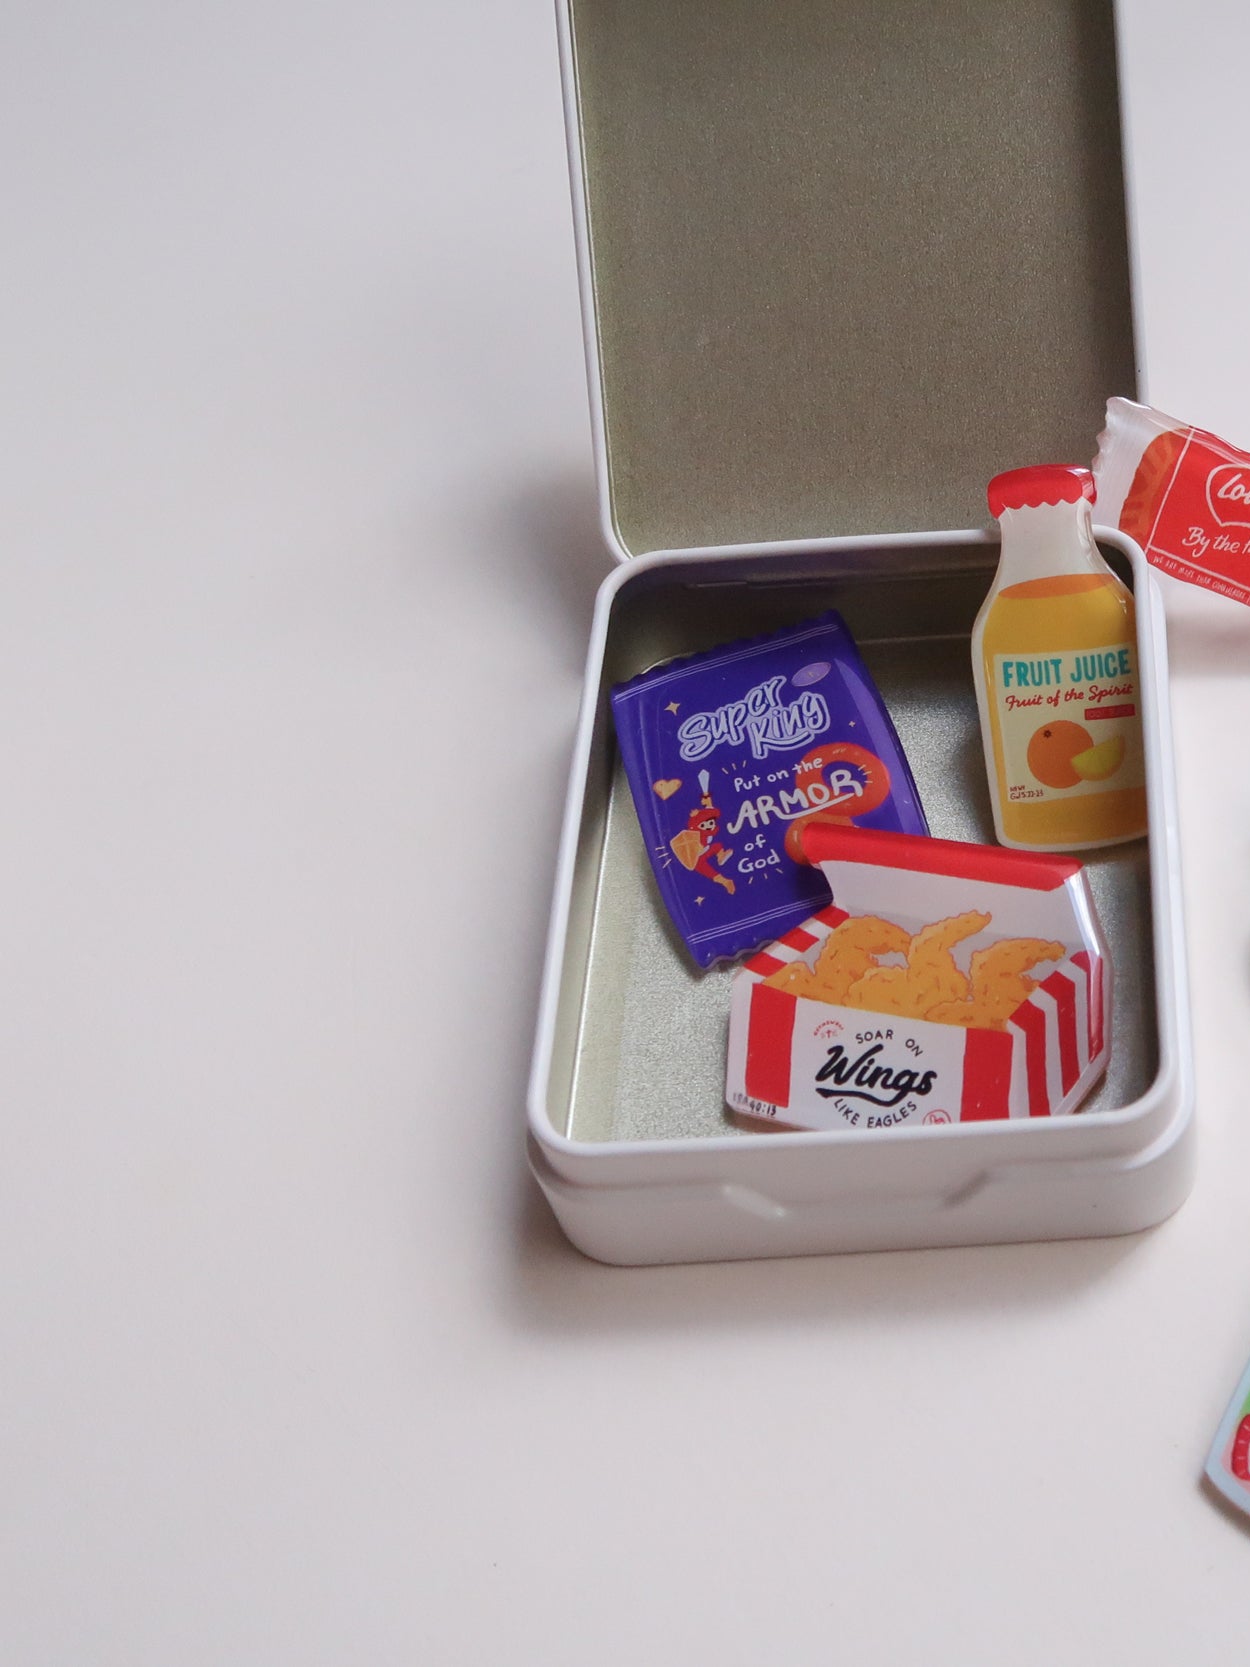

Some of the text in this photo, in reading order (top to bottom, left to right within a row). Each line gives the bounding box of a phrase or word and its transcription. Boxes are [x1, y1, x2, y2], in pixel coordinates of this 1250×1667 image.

[1182, 526, 1210, 557] By
[1212, 531, 1241, 554] the
[1002, 649, 1132, 688] FRUIT JUICE
[1005, 684, 1134, 711] Fruit of the Spirit
[734, 756, 823, 793] Put on the
[727, 769, 865, 836] ARMOR
[744, 833, 767, 852] of
[737, 849, 782, 874] God
[855, 1029, 924, 1057] SOAR ON
[814, 1044, 938, 1106] Wings
[833, 1098, 917, 1129] LIKE EAGLES
